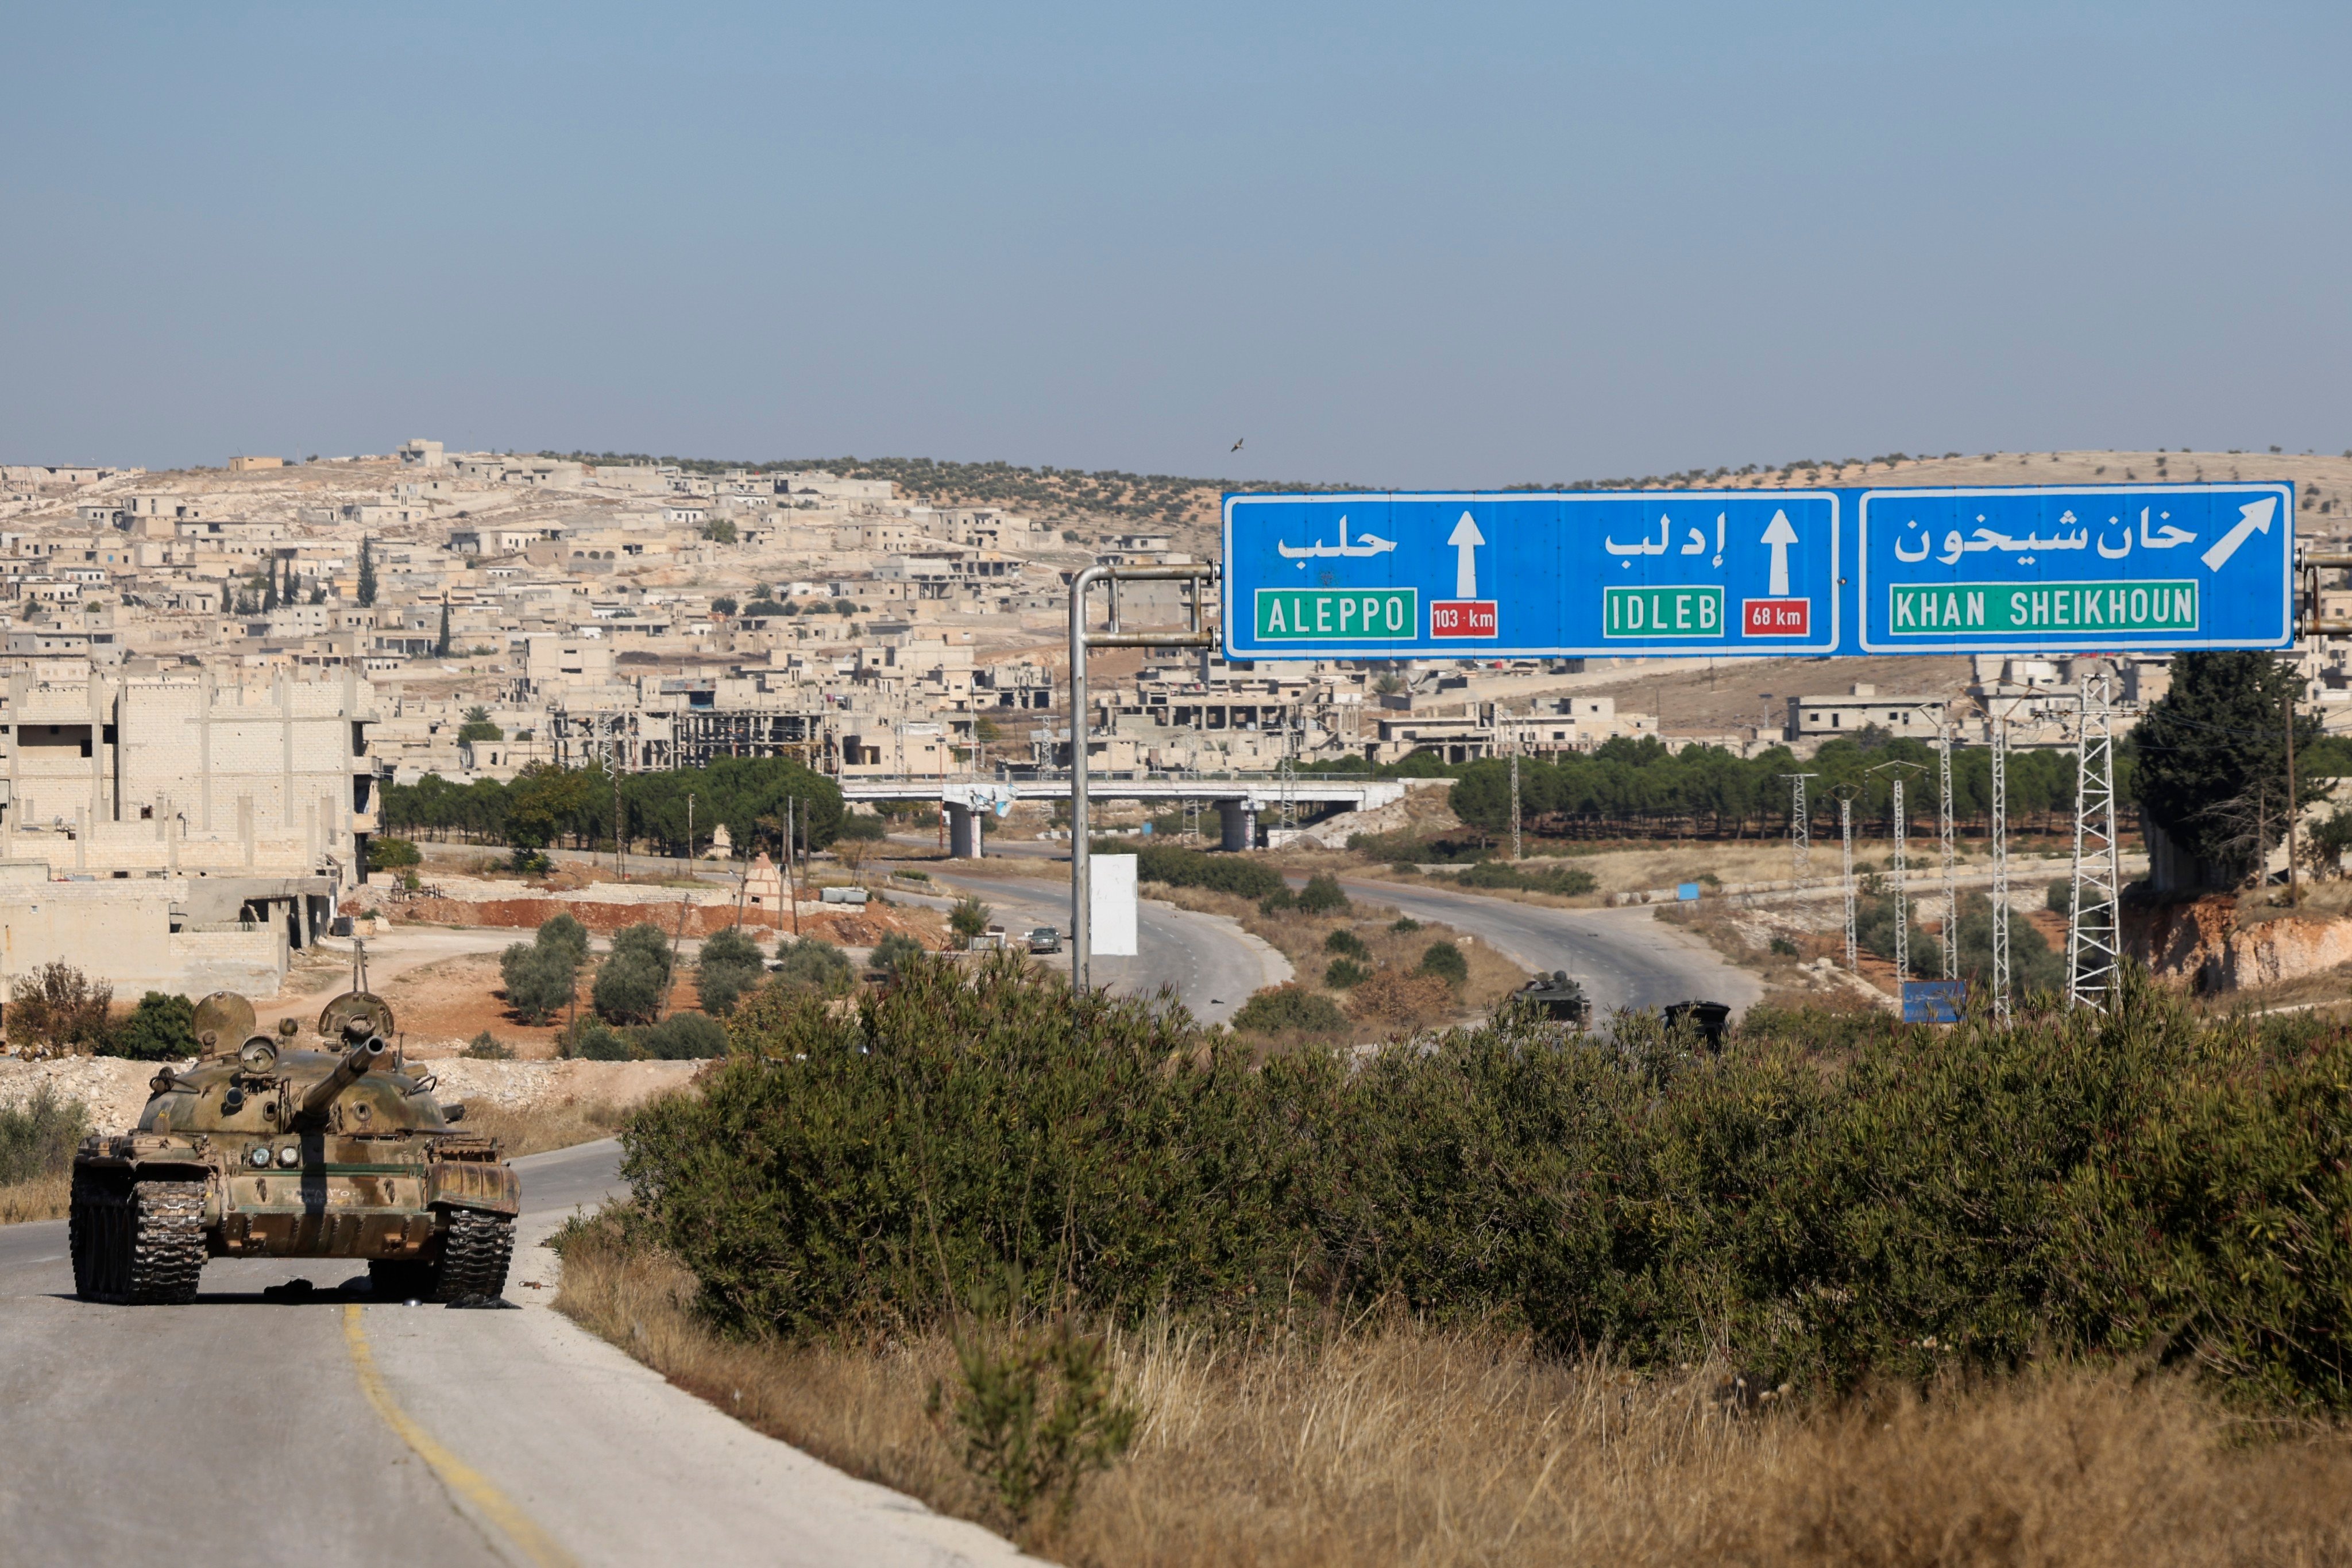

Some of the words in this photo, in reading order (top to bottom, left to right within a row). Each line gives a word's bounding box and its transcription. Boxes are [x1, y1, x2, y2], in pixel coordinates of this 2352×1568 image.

[1278, 515, 1398, 570] حلب
[1605, 511, 1725, 569] إدلب
[1895, 510, 2088, 566] شيخون
[2097, 507, 2198, 559] خان
[1268, 597, 1403, 632] ALEPPO
[1434, 609, 1458, 628] 103
[1469, 609, 1493, 627] km
[1613, 595, 1716, 629] IDLEB
[1752, 607, 1771, 625] 68
[1776, 607, 1801, 625] km
[1897, 592, 1985, 627] KHAN
[2010, 588, 2192, 625] SHEIKHOUN
